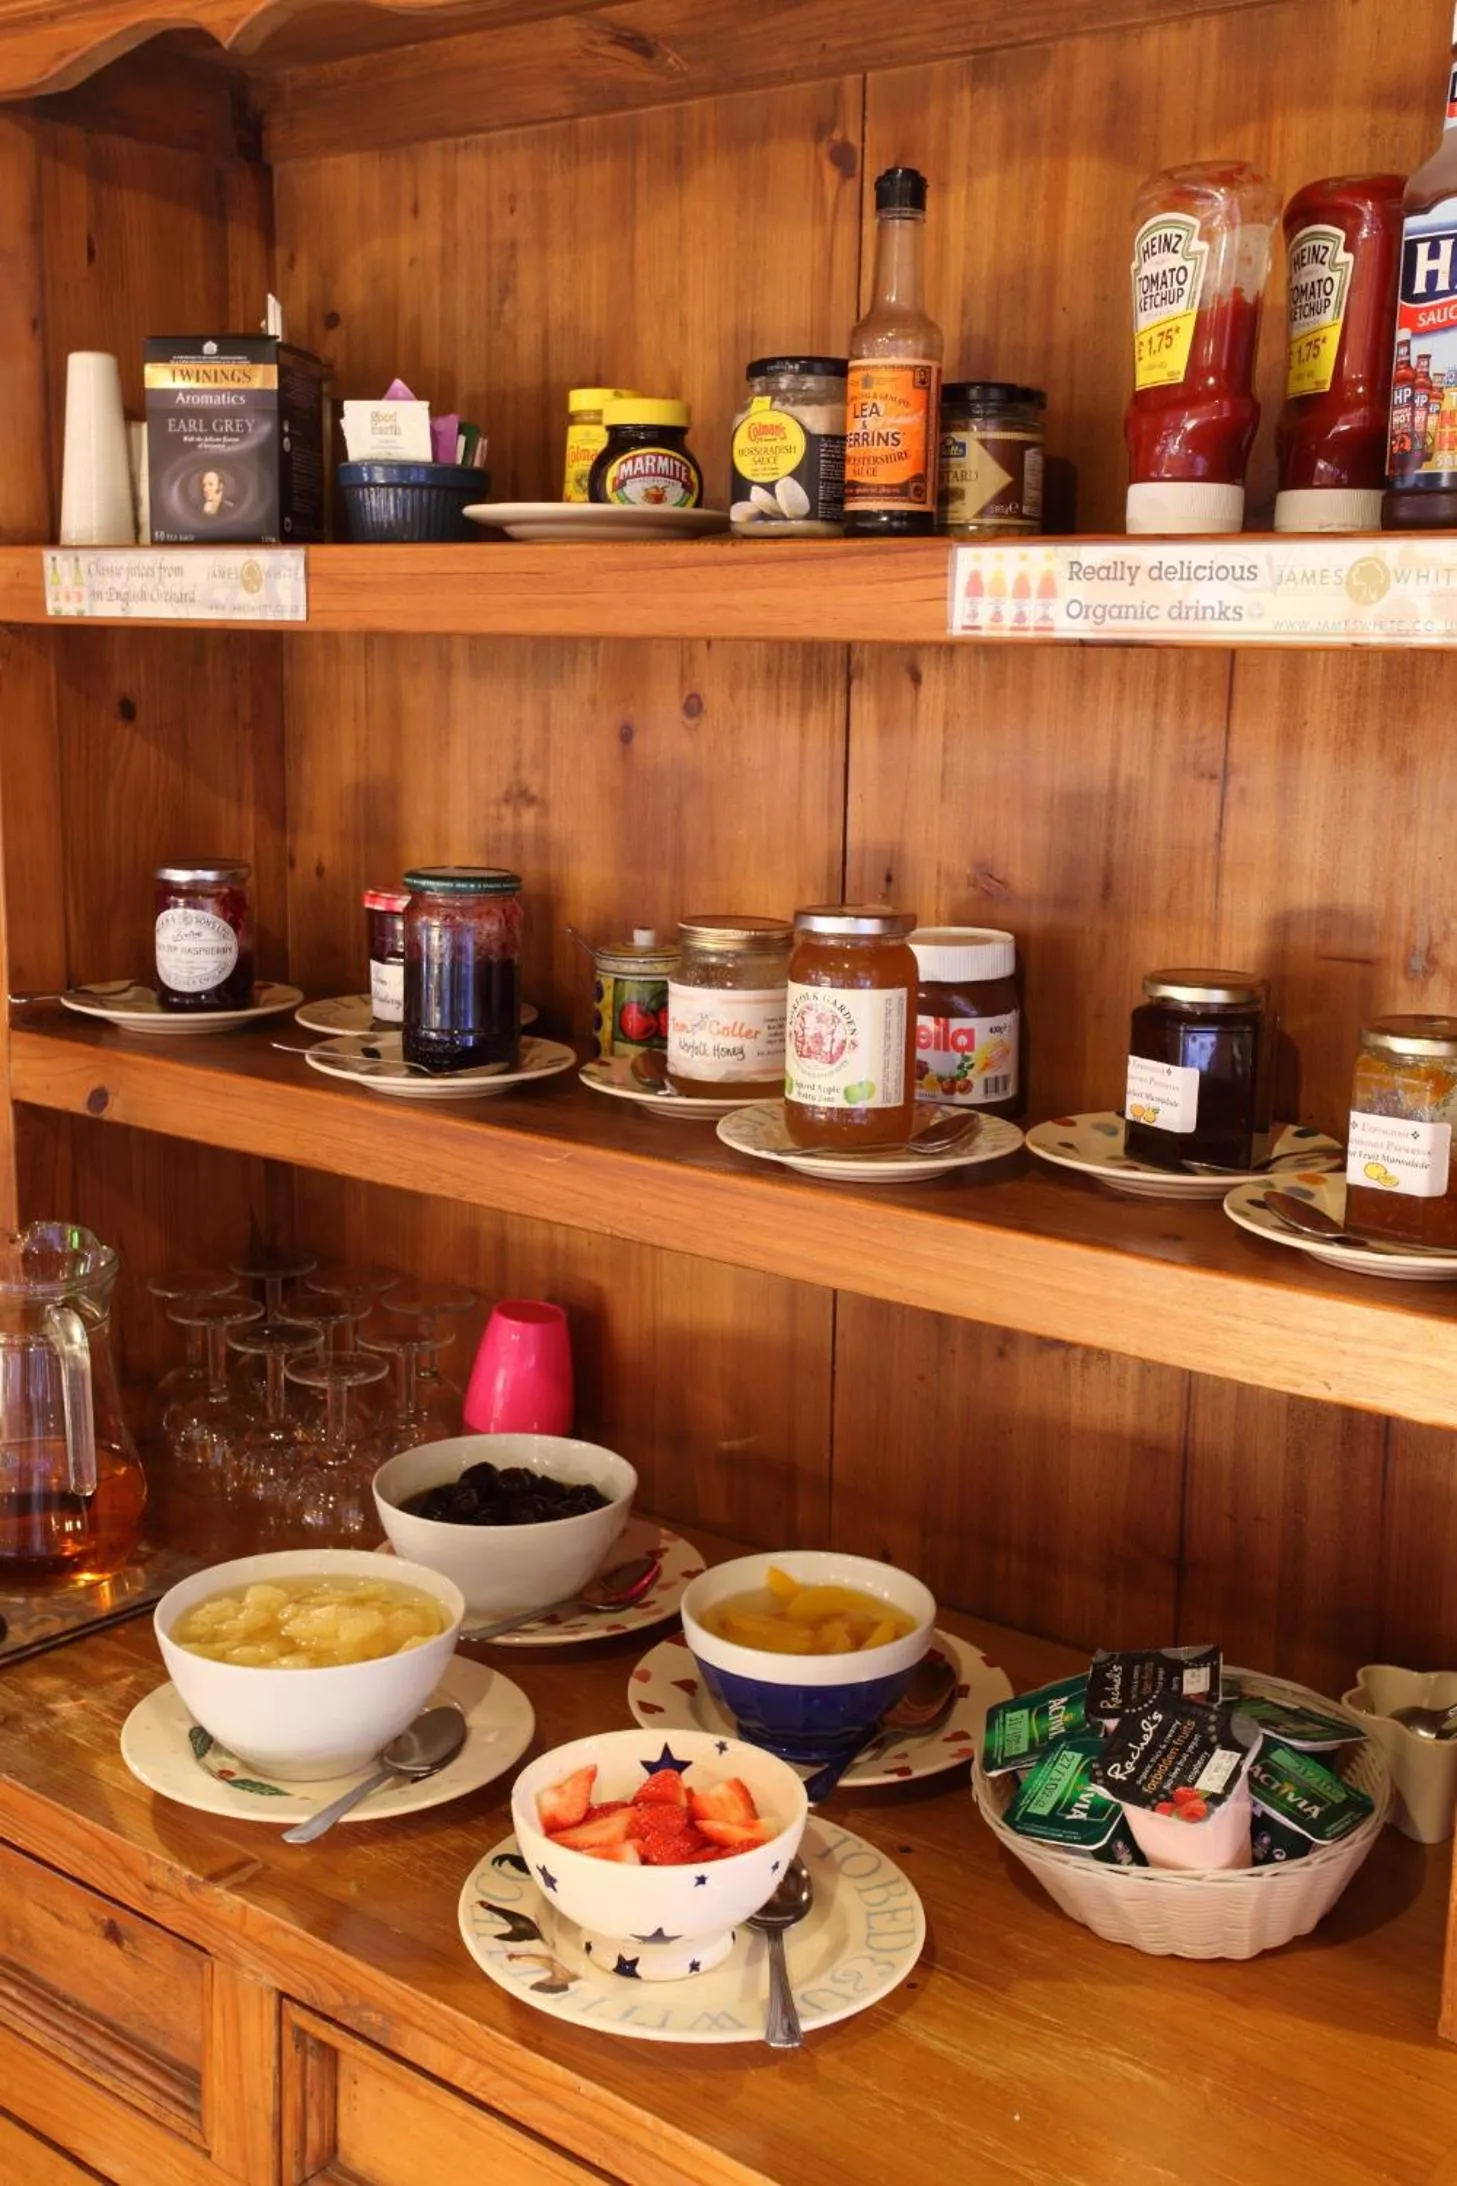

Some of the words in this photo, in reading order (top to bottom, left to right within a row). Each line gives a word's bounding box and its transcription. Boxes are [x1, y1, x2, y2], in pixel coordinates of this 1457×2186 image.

[1142, 233, 1182, 262] HEINZ
[1293, 244, 1329, 272] HEINZ
[1138, 265, 1188, 296] TOMATO
[1413, 240, 1457, 295] H
[171, 368, 252, 383] TWININGS
[175, 391, 246, 406] Aromatics
[1393, 387, 1412, 405] HP
[853, 402, 881, 419] LEA
[167, 418, 207, 432] EARL
[212, 419, 255, 433] GREY
[861, 420, 868, 429] &
[846, 431, 901, 448] ERRINS
[619, 454, 689, 483] MARMITE
[944, 469, 978, 482] TARD
[1068, 560, 1141, 586] Really
[1147, 560, 1258, 582] delicious
[1275, 569, 1344, 587] JAMES
[107, 586, 147, 611] English
[150, 584, 196, 603] Orchard
[1065, 599, 1164, 625] Organic
[1168, 600, 1244, 622] drinks
[712, 1043, 746, 1061] Honey
[1107, 1710, 1163, 1781] Rachel's
[1143, 1740, 1181, 1794] forbidden
[1173, 1719, 1196, 1746] fruits
[1249, 1764, 1322, 1819] ACTIVIA
